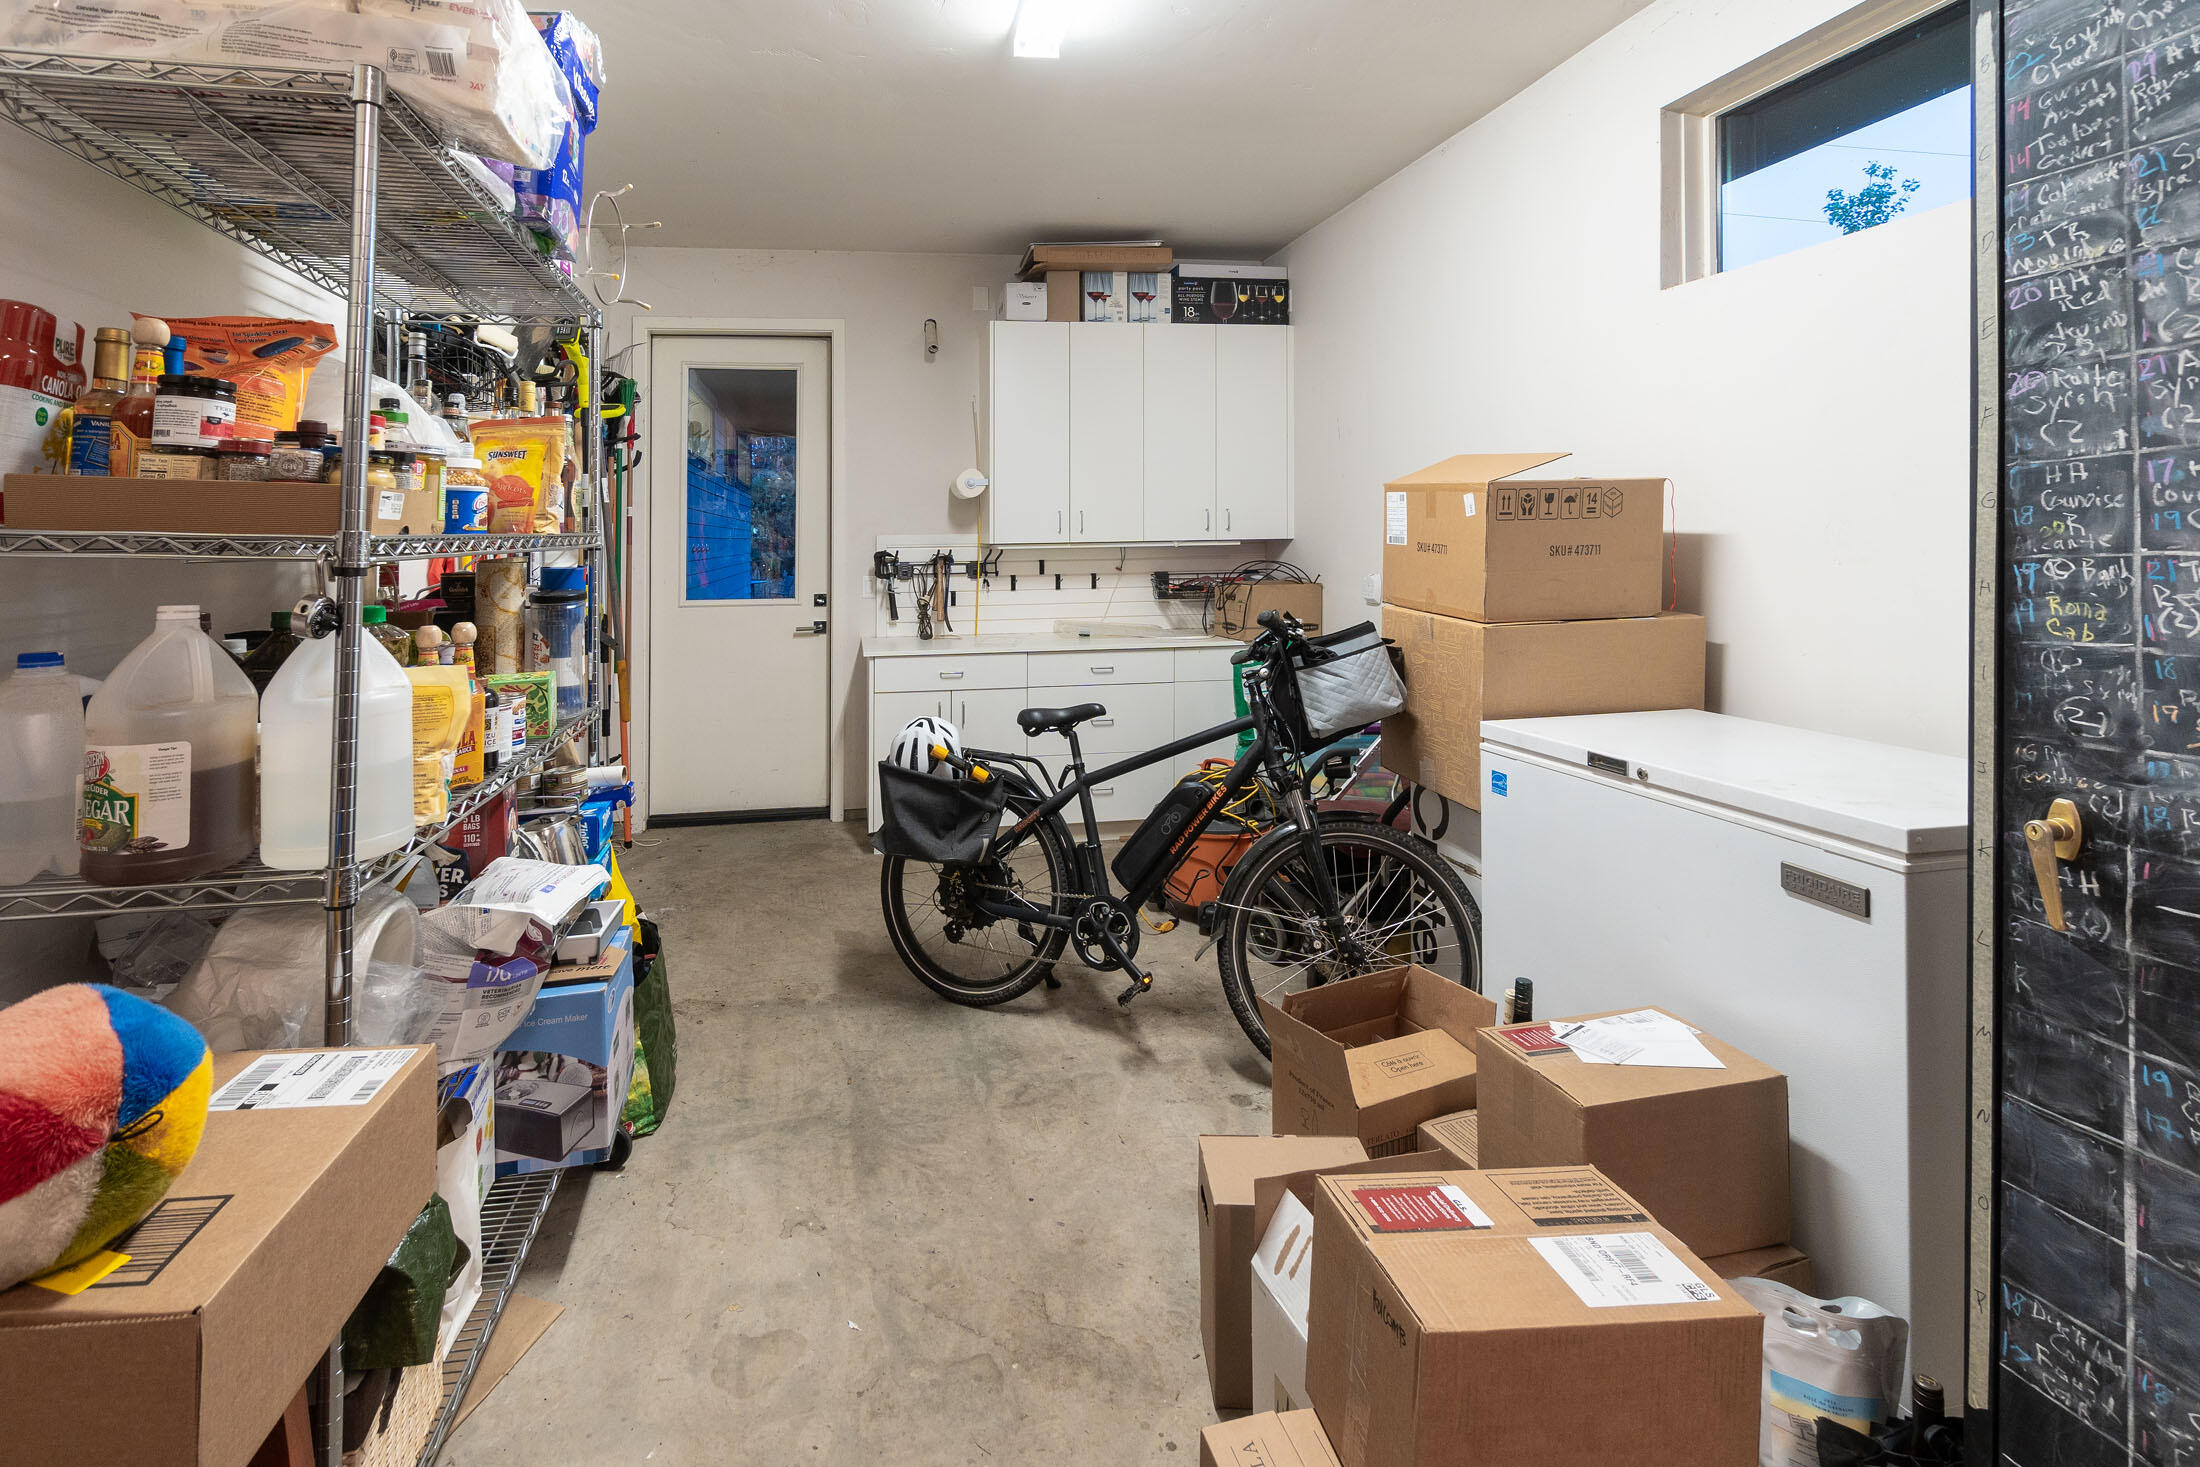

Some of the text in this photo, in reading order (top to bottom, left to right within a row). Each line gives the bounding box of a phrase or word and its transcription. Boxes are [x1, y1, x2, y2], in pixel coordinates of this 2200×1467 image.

[1183, 306, 1195, 318] 18
[55, 337, 75, 356] PURE
[41, 375, 74, 399] CANOLA
[32, 393, 54, 405] COOKING
[487, 449, 527, 461] SUNSWEET
[1586, 492, 1598, 506] 14
[470, 813, 480, 823] LB
[1169, 784, 1228, 855] RAD POWER BIKES
[463, 821, 480, 831] BAGS
[1783, 867, 1862, 902] FRIGIDAIRE
[524, 1013, 589, 1027] Ice Cream Maker
[1408, 1060, 1425, 1069] here
